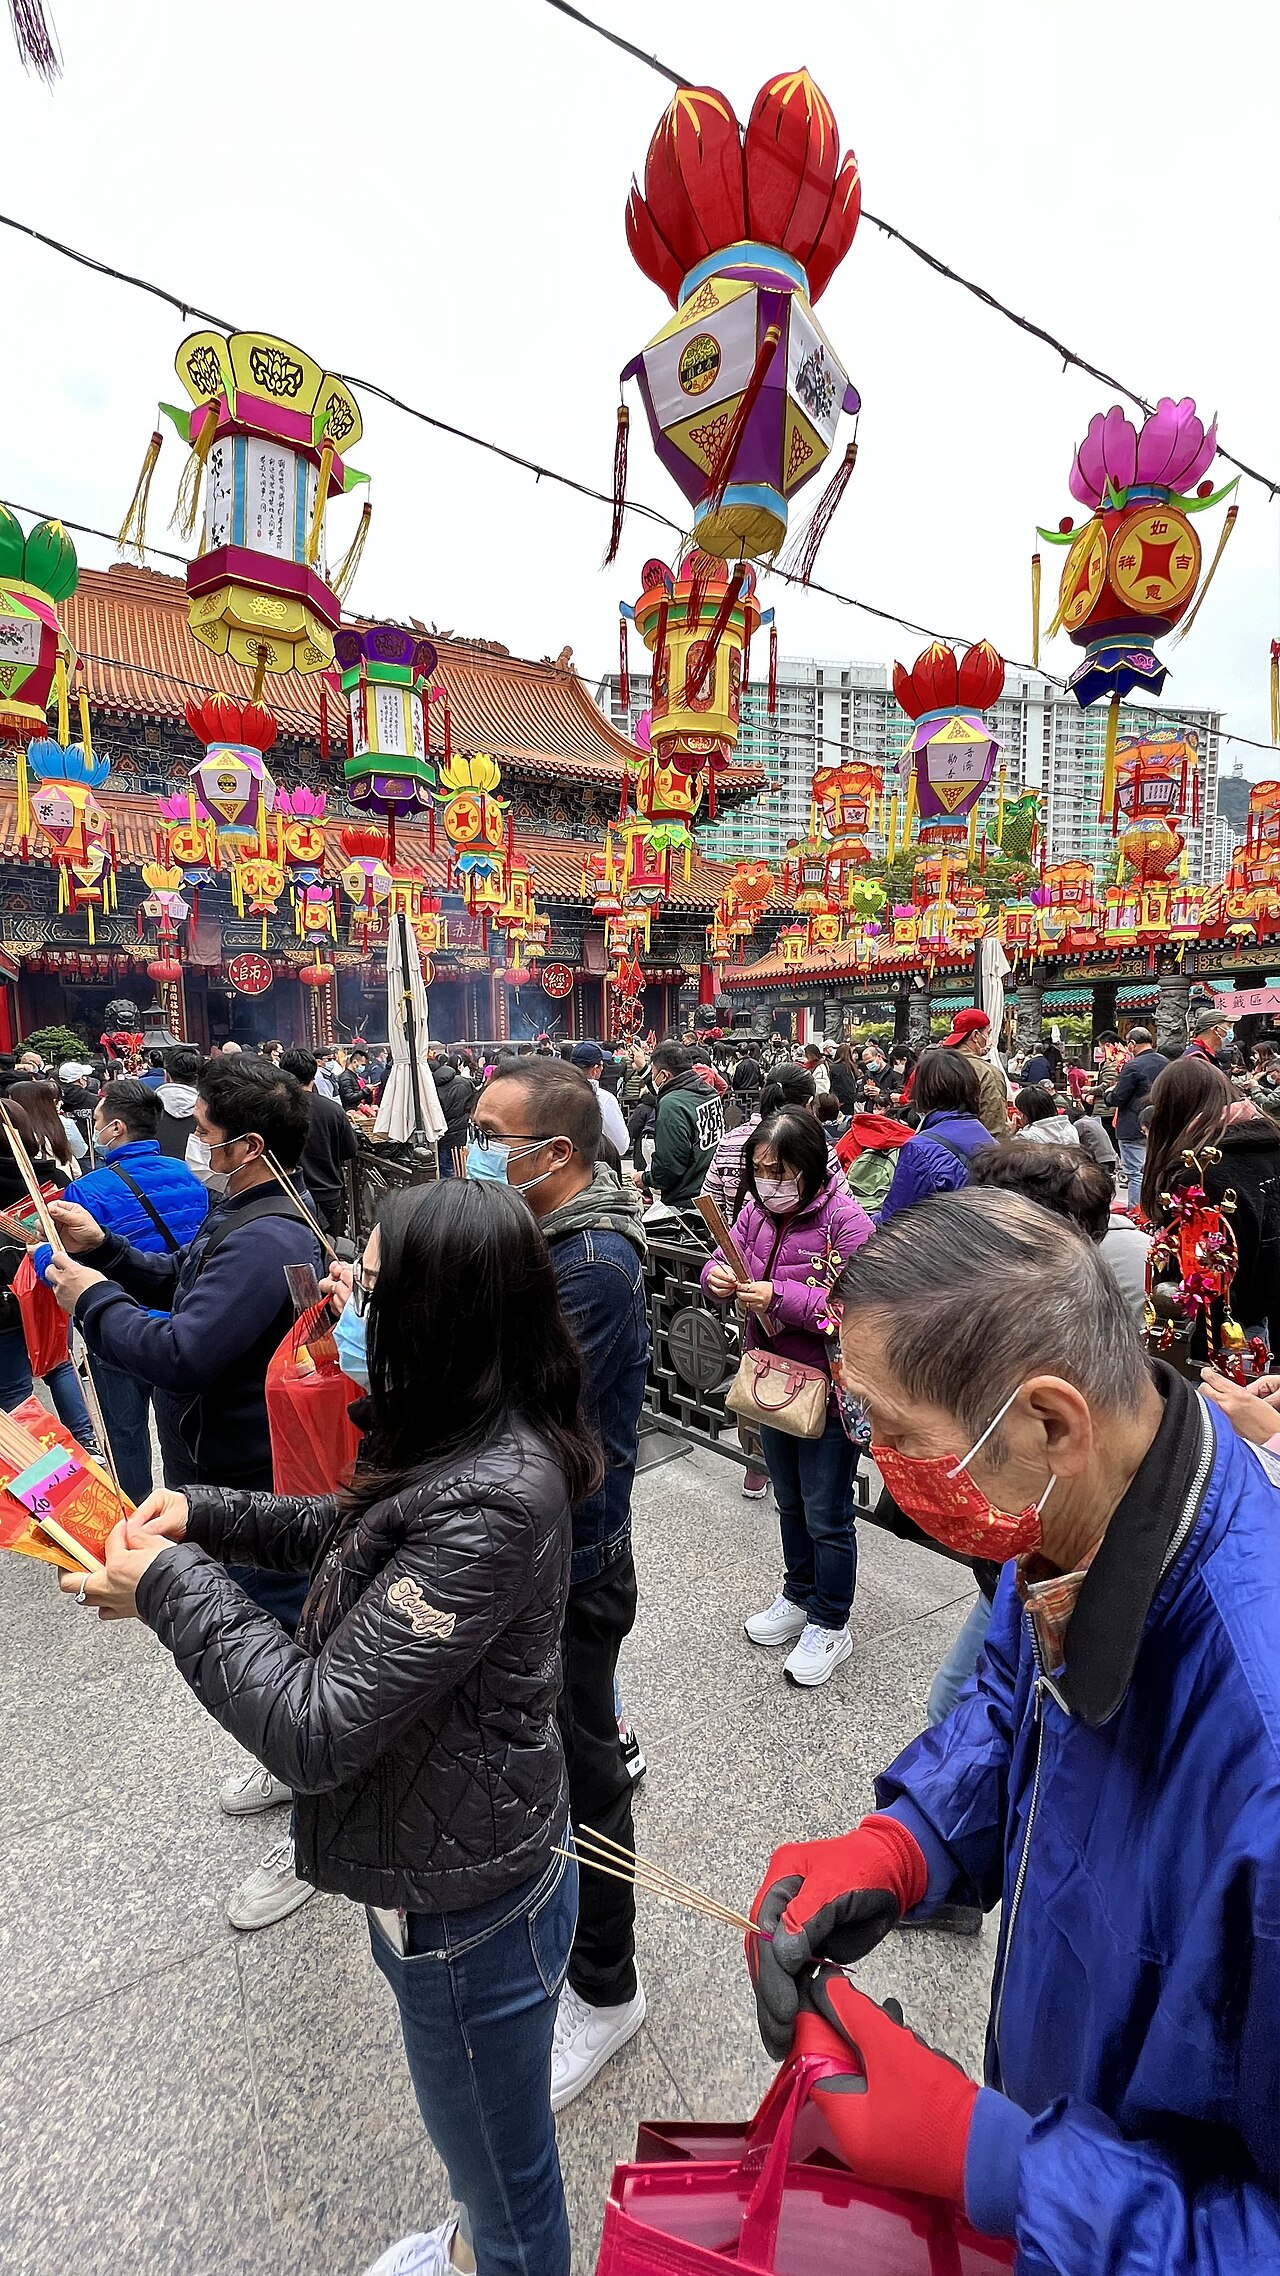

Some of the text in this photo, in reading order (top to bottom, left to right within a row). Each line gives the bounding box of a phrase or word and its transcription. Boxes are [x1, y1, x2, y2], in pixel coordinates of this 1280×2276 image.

[1150, 520, 1169, 536] 如
[1118, 554, 1137, 571] 祥
[1175, 553, 1193, 570] 吉
[1145, 584, 1162, 600] 意
[240, 961, 261, 985] 師
[390, 1580, 456, 1636] Tough
